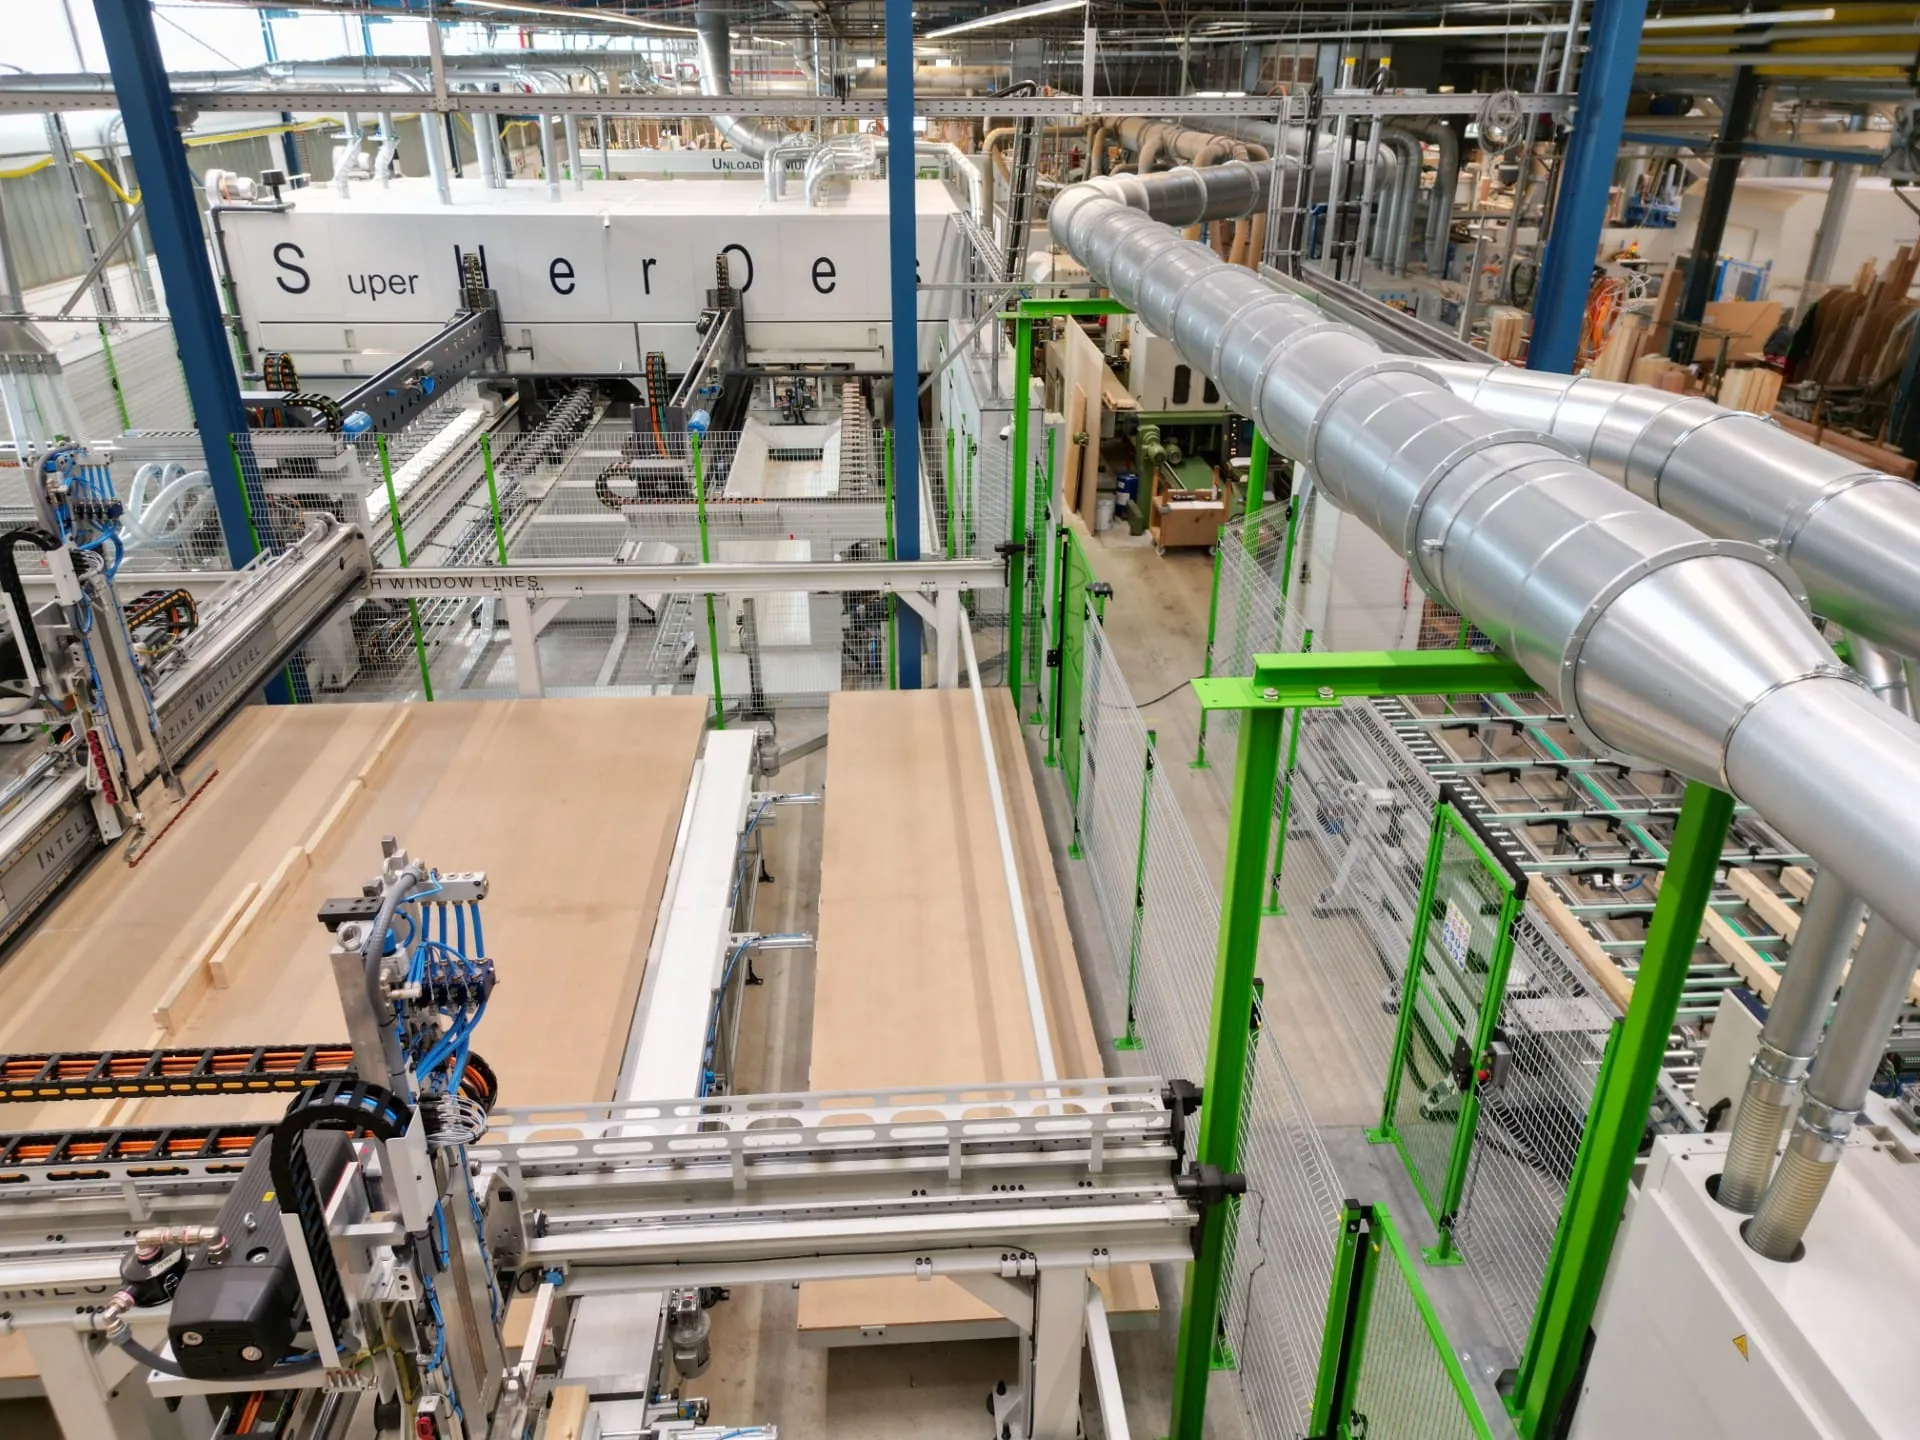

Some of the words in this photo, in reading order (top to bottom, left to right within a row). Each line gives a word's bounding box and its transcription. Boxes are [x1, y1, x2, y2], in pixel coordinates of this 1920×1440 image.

[389, 576, 473, 589] WINDOW
[482, 575, 539, 589] LINES
[36, 813, 92, 870] INTELL
